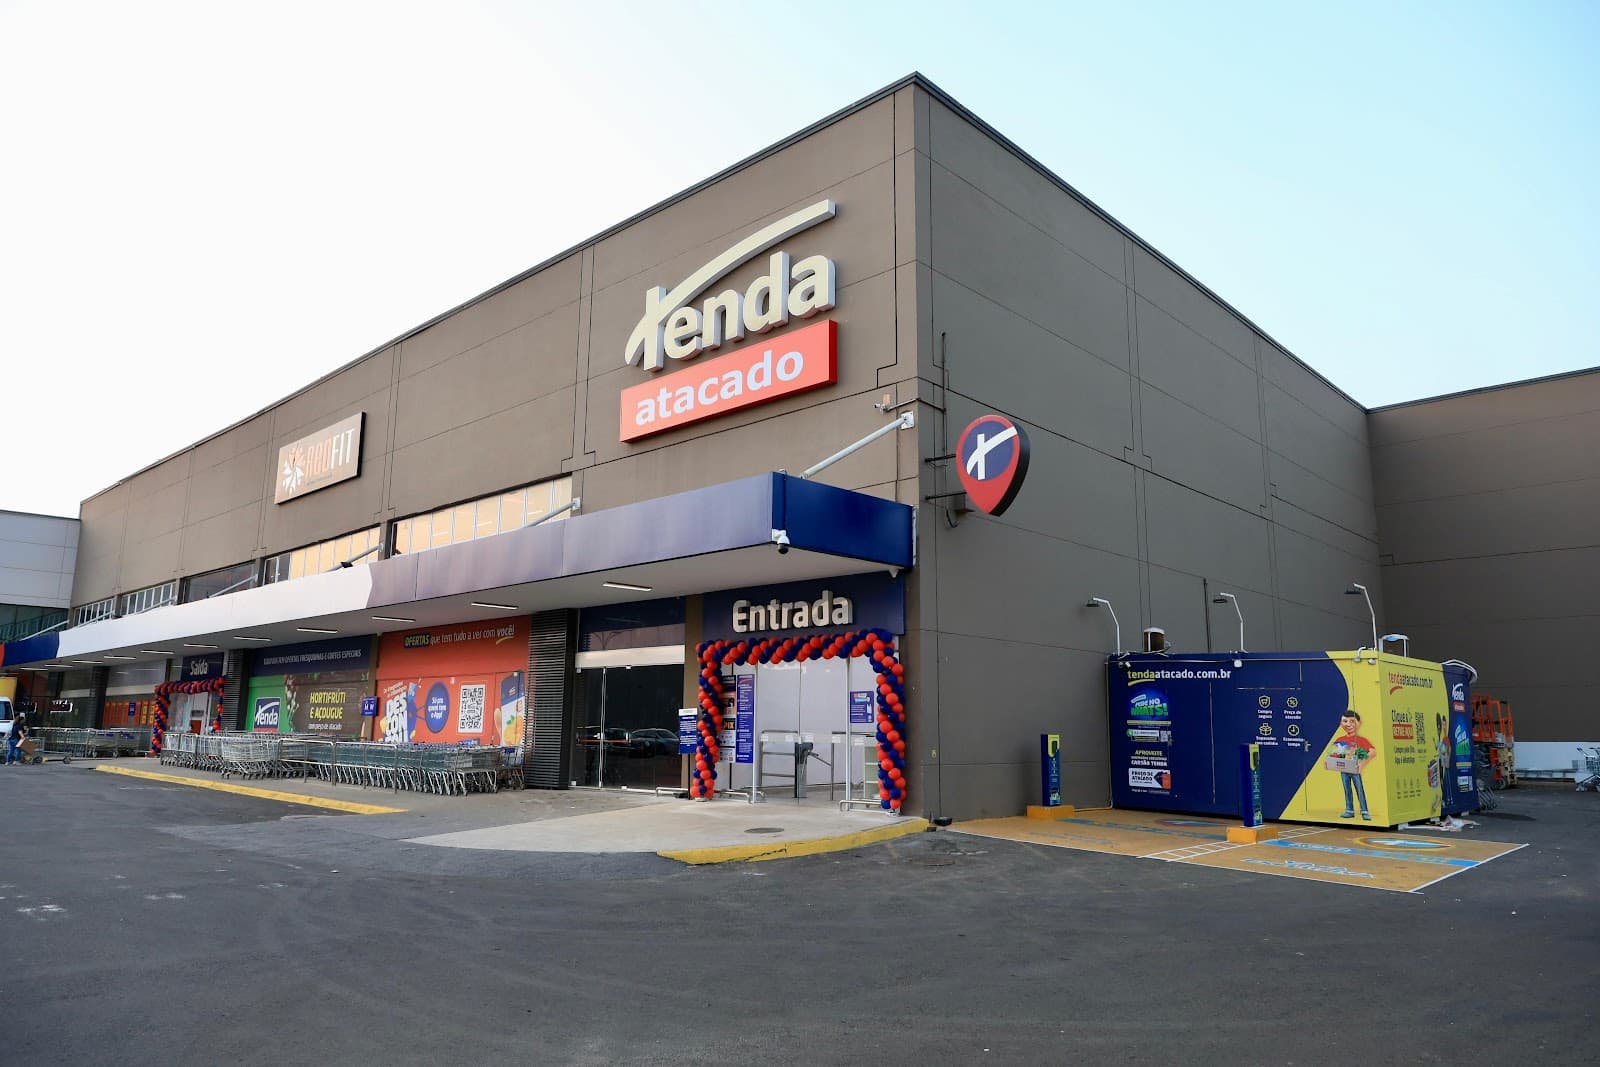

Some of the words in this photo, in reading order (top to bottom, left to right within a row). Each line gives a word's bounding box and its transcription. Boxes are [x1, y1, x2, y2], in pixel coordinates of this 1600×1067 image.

[635, 350, 804, 426] atacado
[732, 590, 853, 633] Entrada
[405, 635, 429, 647] OFERTAS
[430, 637, 440, 646] que
[454, 632, 467, 641] tudo
[472, 631, 482, 639] ver
[483, 629, 496, 638] com
[496, 624, 515, 637] você!
[1127, 668, 1232, 679] tendaatacado.com.br
[310, 689, 346, 704] HORTIFRÚTI
[309, 707, 314, 719] E
[314, 706, 343, 722] AÇOUGUE
